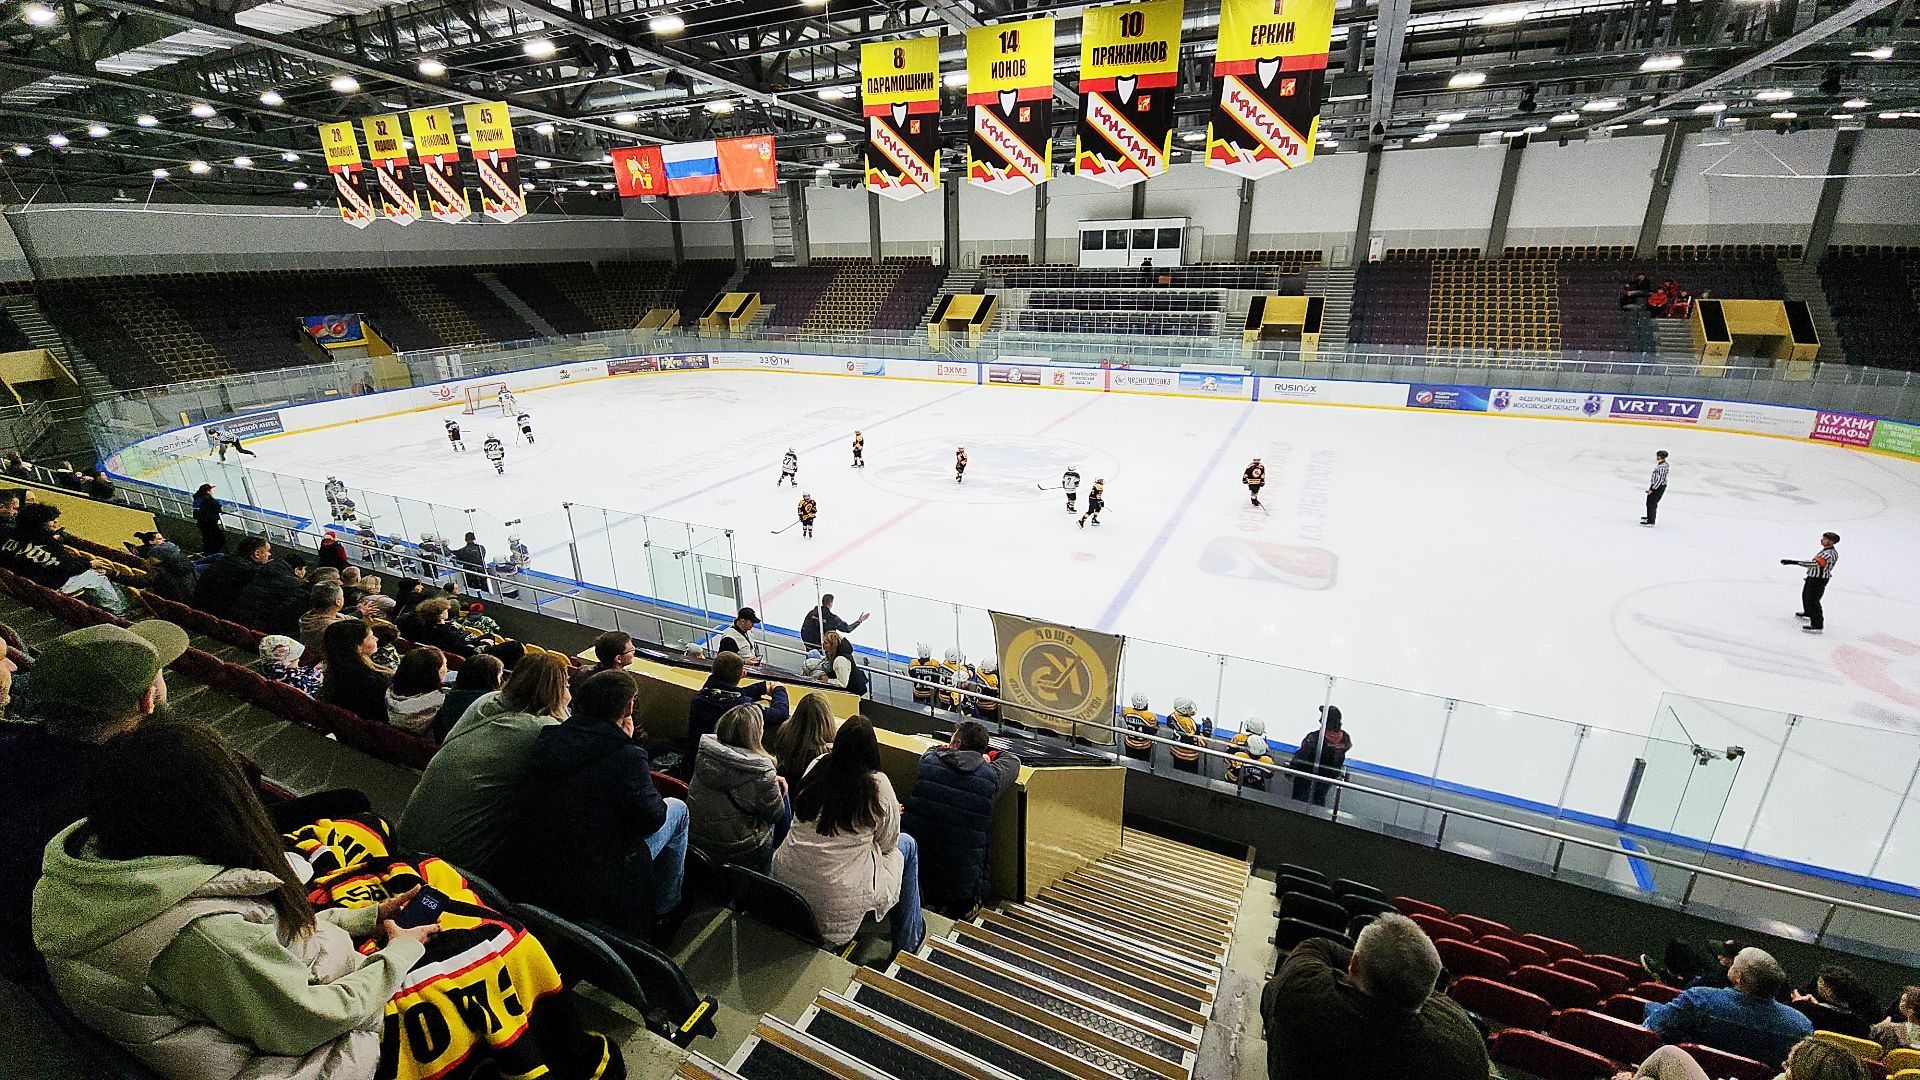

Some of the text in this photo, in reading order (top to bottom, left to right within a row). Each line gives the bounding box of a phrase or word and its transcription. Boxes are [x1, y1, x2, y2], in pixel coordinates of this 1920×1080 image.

[1119, 11, 1145, 38] 10
[1250, 22, 1296, 46] ЕРКИН
[999, 30, 1020, 54] 14
[893, 48, 906, 69] 8
[1092, 41, 1168, 67] ПРЯЖНИКОВ
[991, 59, 1027, 79] ИОНОВ
[867, 72, 934, 94] ПАРАМОШКИН
[426, 115, 436, 130] 11
[480, 109, 493, 124] 45
[1230, 91, 1299, 156] КРИСТАЛЛ
[376, 121, 388, 136] 32
[1094, 106, 1156, 168] КРИСТАЛЛ
[876, 129, 929, 183] КРИСТАЛЛ
[981, 119, 1038, 174] КРИСТАЛЛ
[1817, 425, 1870, 440] ШКАФЫ
[1819, 414, 1875, 430] КУХНИ
